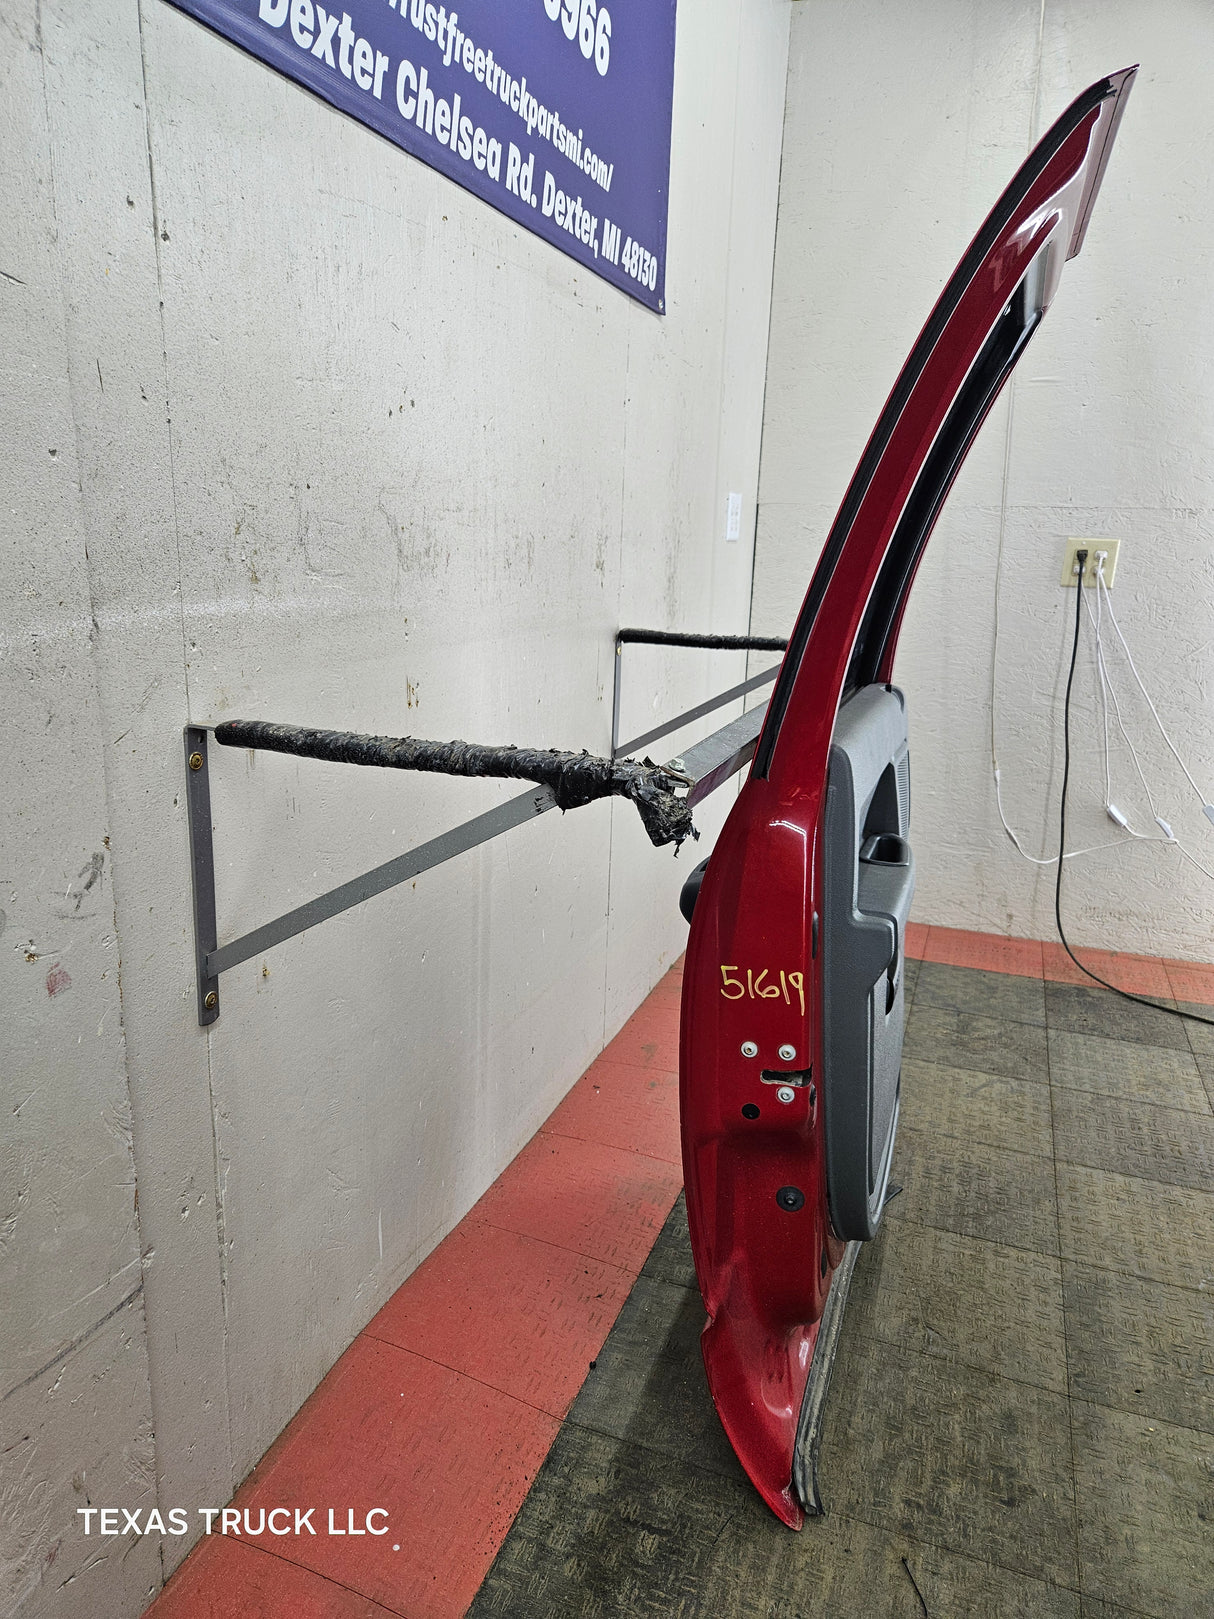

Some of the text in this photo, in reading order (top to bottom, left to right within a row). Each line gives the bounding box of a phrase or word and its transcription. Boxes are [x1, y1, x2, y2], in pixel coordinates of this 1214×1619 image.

[543, 0, 612, 76] 966
[396, 59, 502, 182] Chelsea
[505, 141, 537, 208] Rd.
[541, 170, 599, 258] Dexter,
[601, 218, 621, 266] MI
[621, 236, 657, 291] 48130
[720, 965, 804, 1016] 51619
